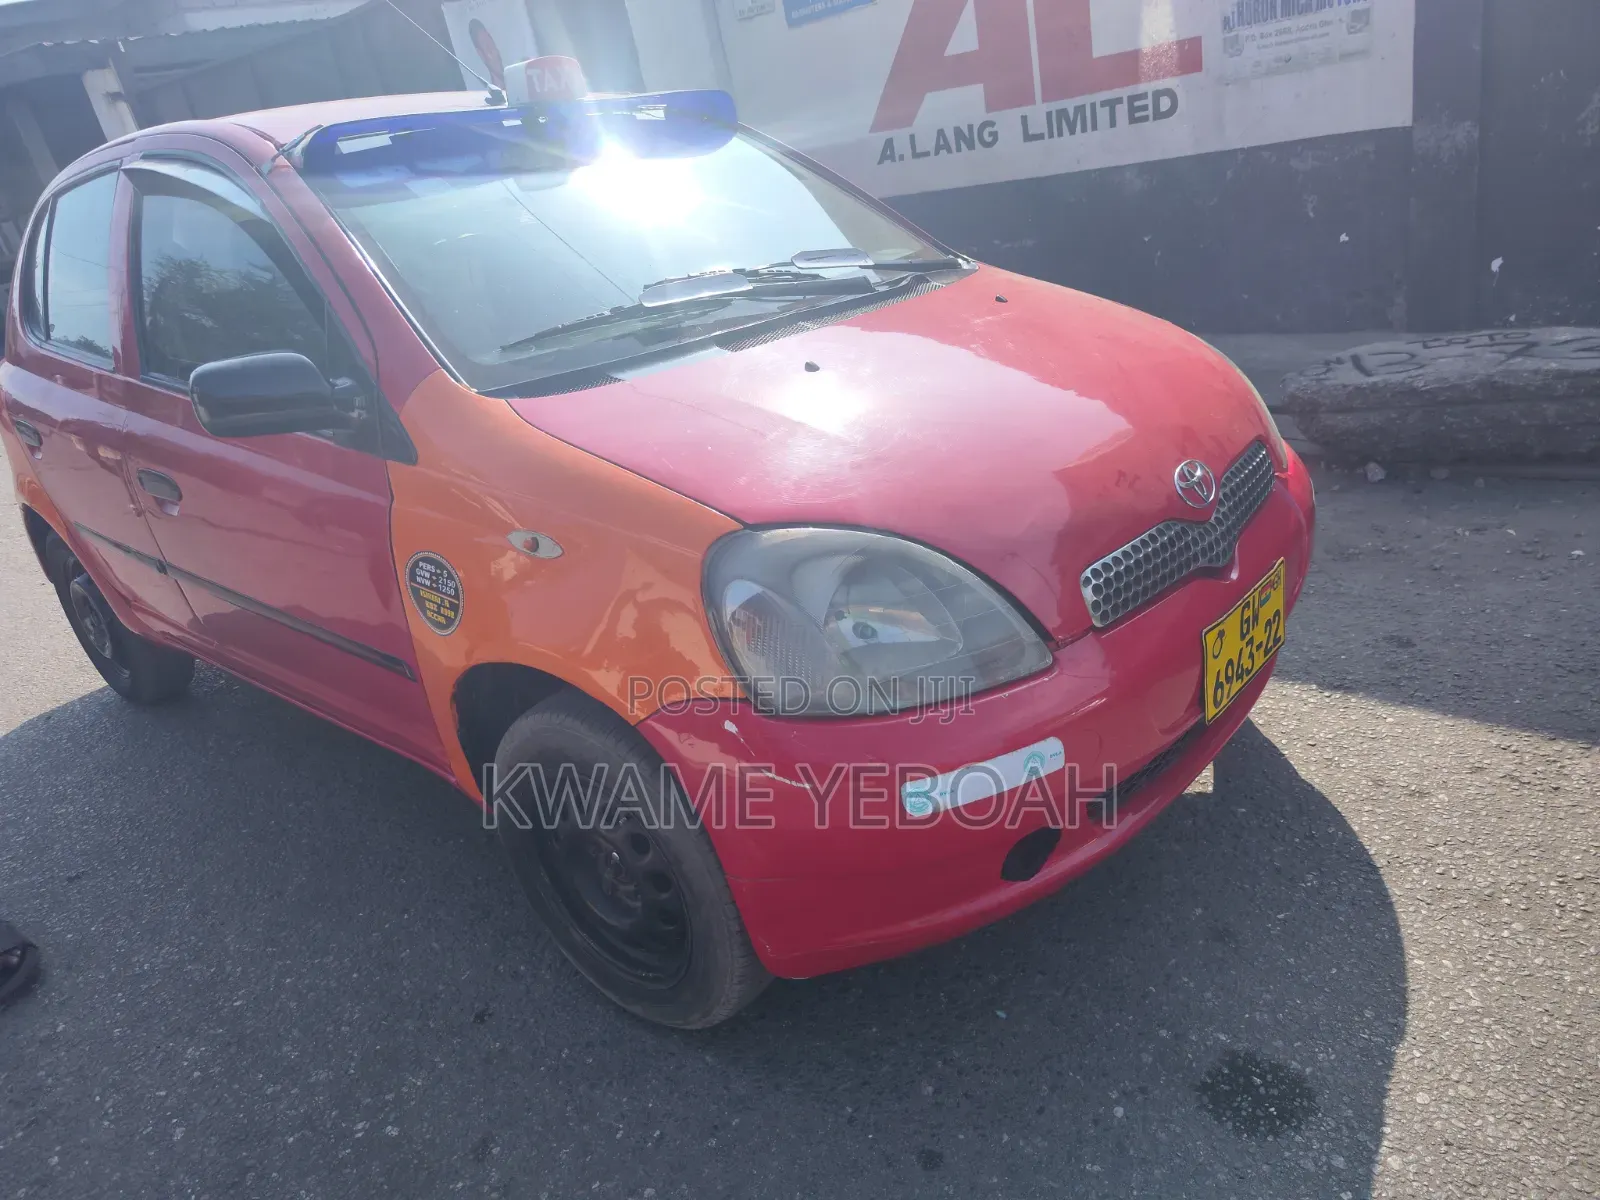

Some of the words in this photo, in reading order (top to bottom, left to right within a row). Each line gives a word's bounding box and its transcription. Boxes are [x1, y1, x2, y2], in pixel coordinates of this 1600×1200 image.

[527, 65, 580, 93] TAX
[877, 120, 999, 165] A.LANG
[1021, 87, 1179, 143] LIMITED
[415, 568, 431, 579] GVW
[438, 576, 456, 589] 2150
[418, 561, 436, 573] PERS
[443, 570, 448, 578] 5
[415, 575, 431, 587] NVW
[438, 584, 455, 596] 1250
[1240, 594, 1261, 642] GW
[1212, 609, 1282, 710] 6943-22
